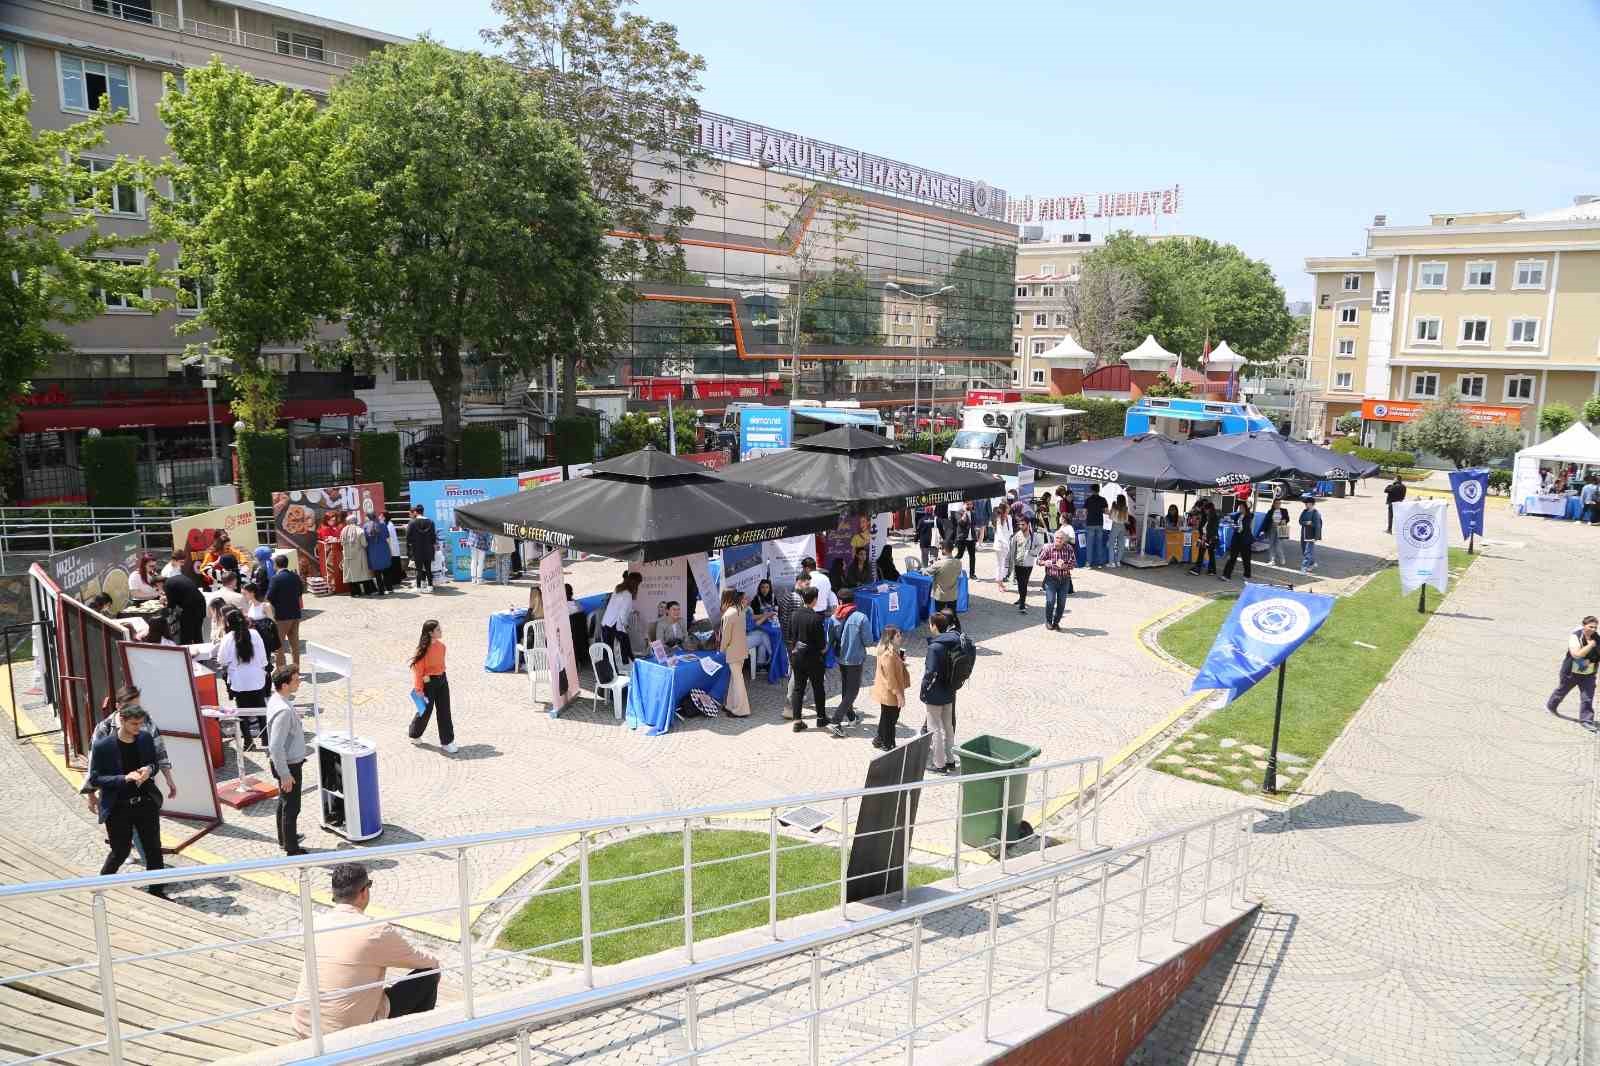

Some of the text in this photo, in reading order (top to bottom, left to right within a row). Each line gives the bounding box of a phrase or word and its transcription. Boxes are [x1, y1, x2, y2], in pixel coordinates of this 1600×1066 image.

[696, 117, 735, 151] TIP
[749, 126, 865, 180] FAKÜLTESİ
[1068, 463, 1119, 482] OBSESSO
[446, 488, 485, 496] mentos
